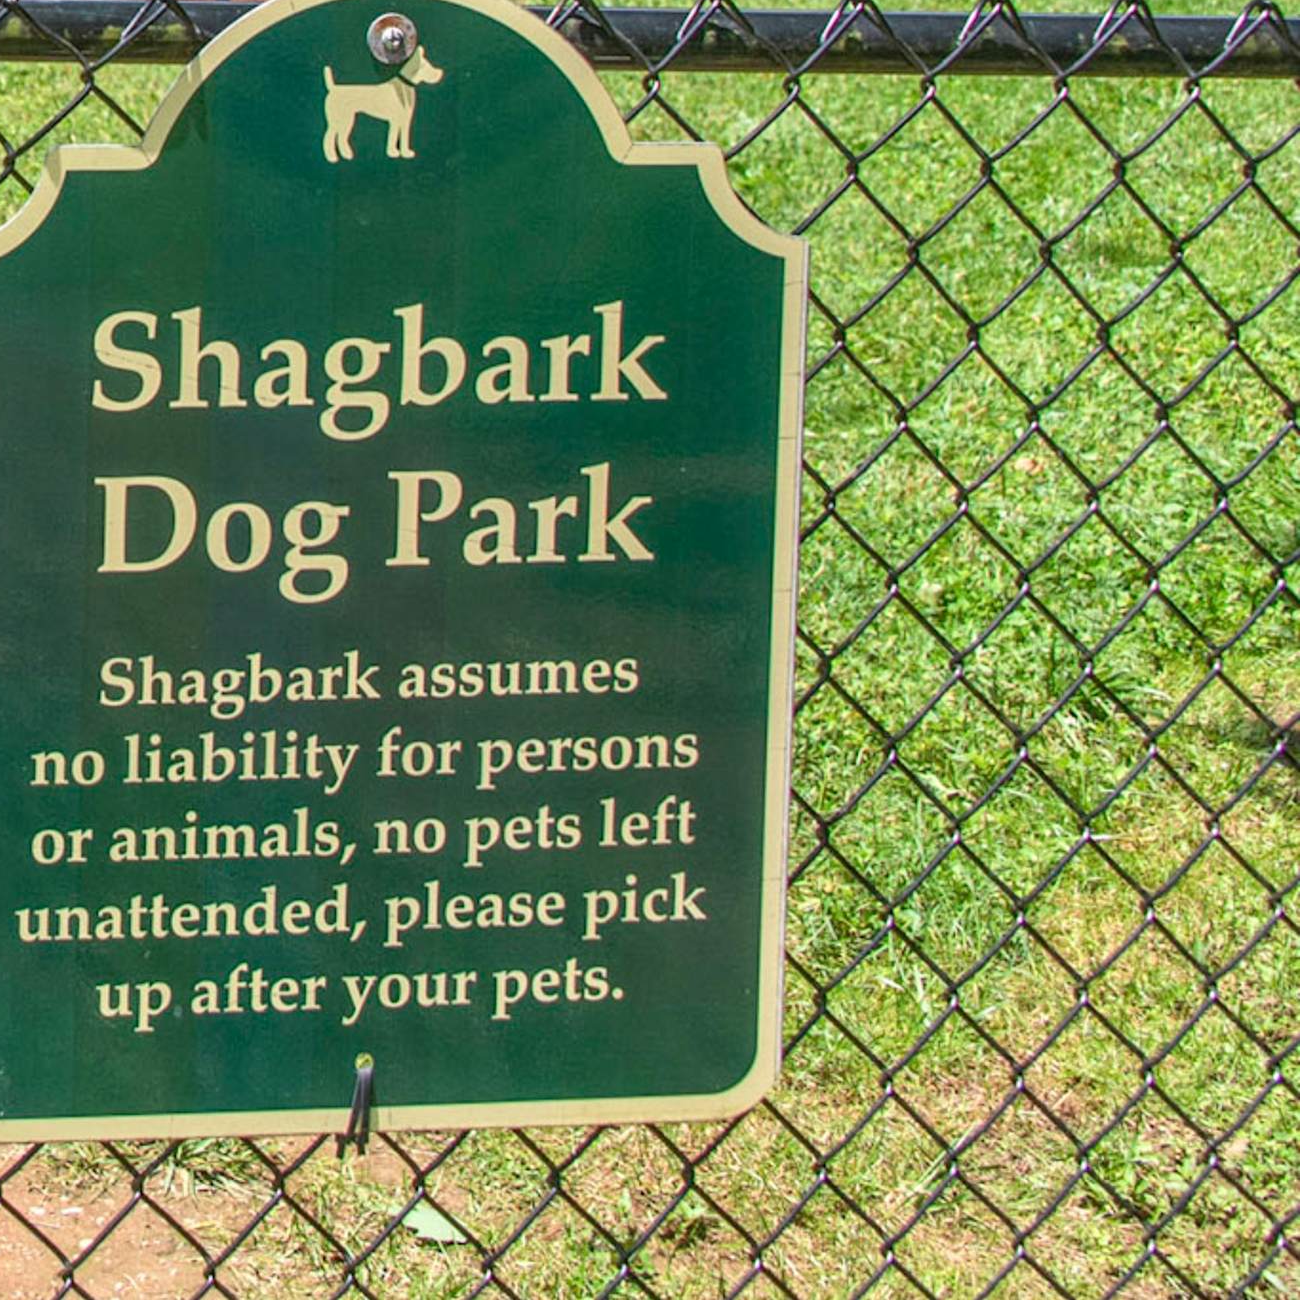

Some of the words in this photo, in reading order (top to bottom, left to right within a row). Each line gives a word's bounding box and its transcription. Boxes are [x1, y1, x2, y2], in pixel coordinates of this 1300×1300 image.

[93, 301, 667, 440] Shagbark
[95, 477, 349, 603] Dog
[386, 463, 654, 566] Park
[101, 651, 380, 719] Shagbark
[399, 659, 638, 698] assumes
[31, 751, 104, 785] no
[124, 731, 359, 794] liability
[378, 727, 461, 776] for
[477, 735, 699, 789] persons
[33, 830, 92, 864] or
[110, 808, 356, 864] animals,
[374, 819, 446, 853] no
[464, 806, 581, 867] pets
[600, 796, 695, 846] left
[16, 884, 365, 942] unattended,
[384, 881, 565, 946] please
[583, 872, 706, 940] pick
[96, 983, 171, 1032] up
[192, 964, 326, 1014] after
[343, 972, 476, 1025] your
[492, 959, 623, 1019] pets.
